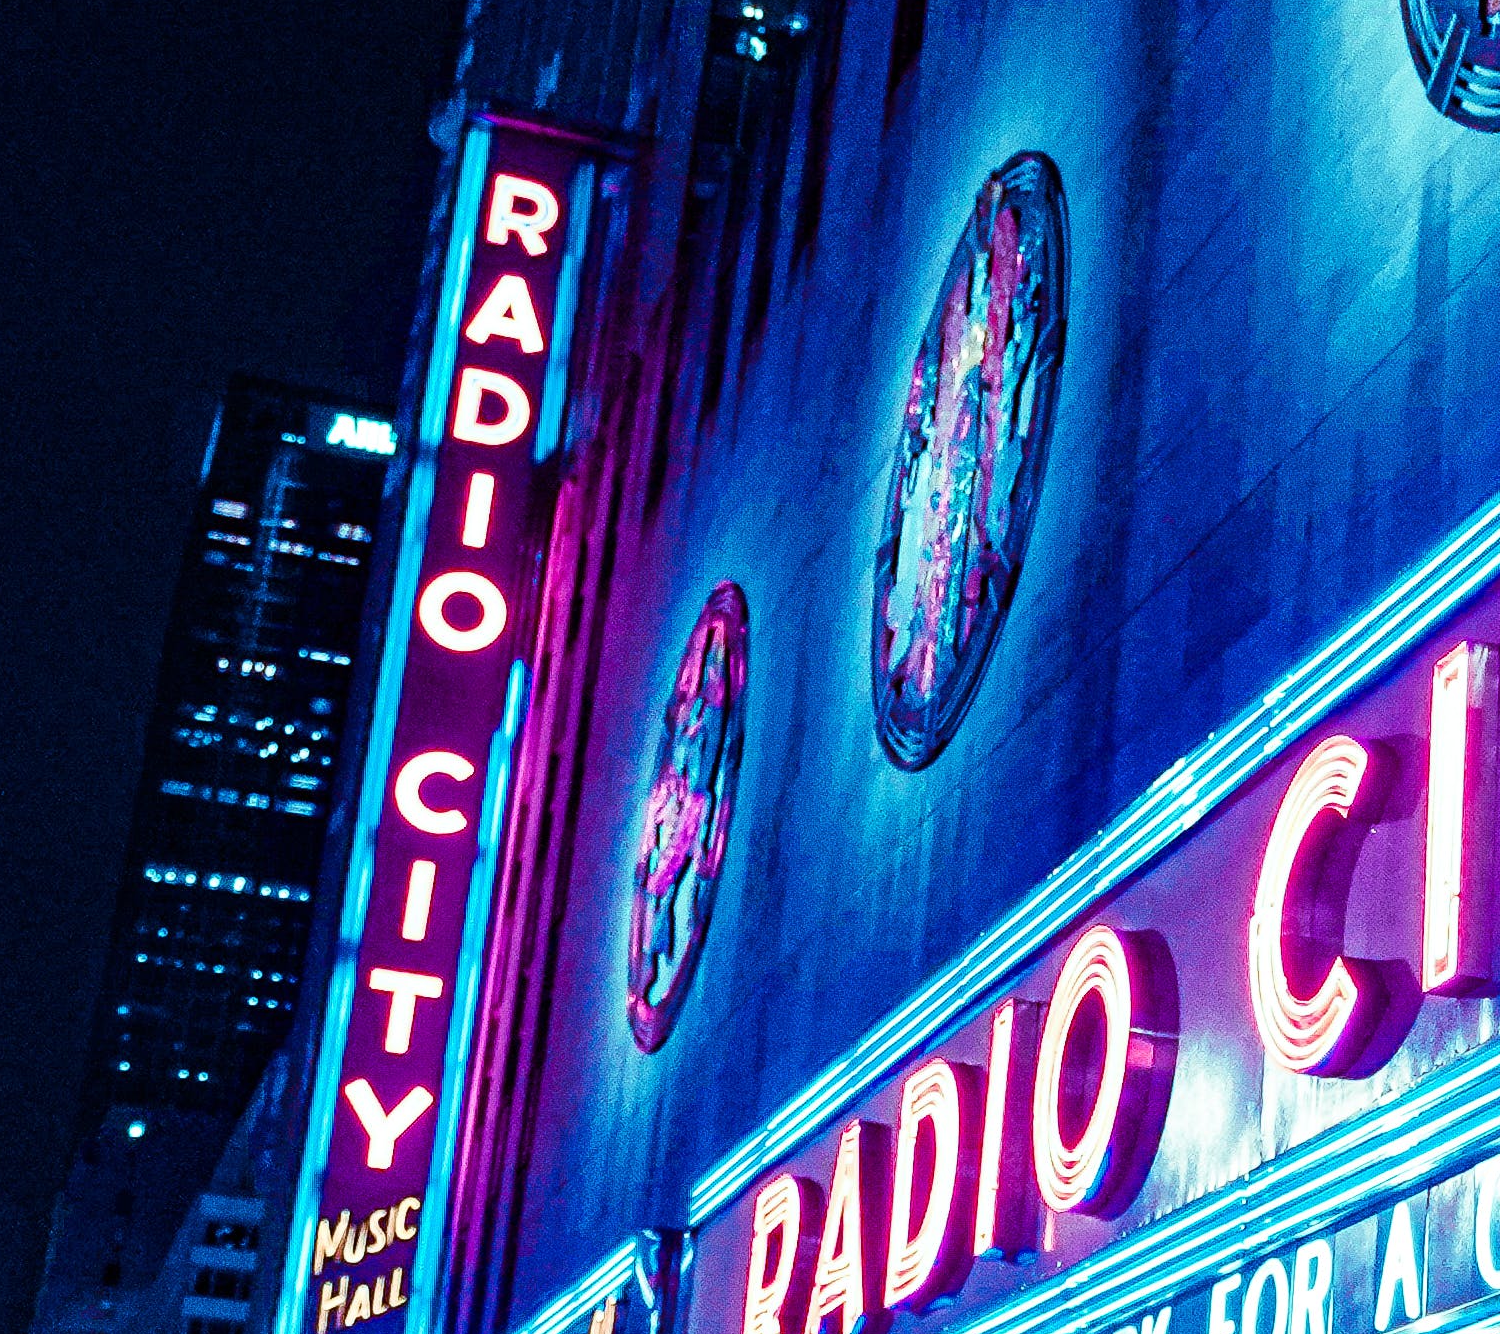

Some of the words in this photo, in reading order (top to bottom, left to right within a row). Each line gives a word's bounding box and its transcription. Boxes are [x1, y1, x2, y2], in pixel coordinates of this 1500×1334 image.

[418, 172, 560, 654] RADIO
[343, 749, 477, 1170] CITY
[313, 1196, 421, 1276] MUSIC
[1374, 1202, 1424, 1332] A
